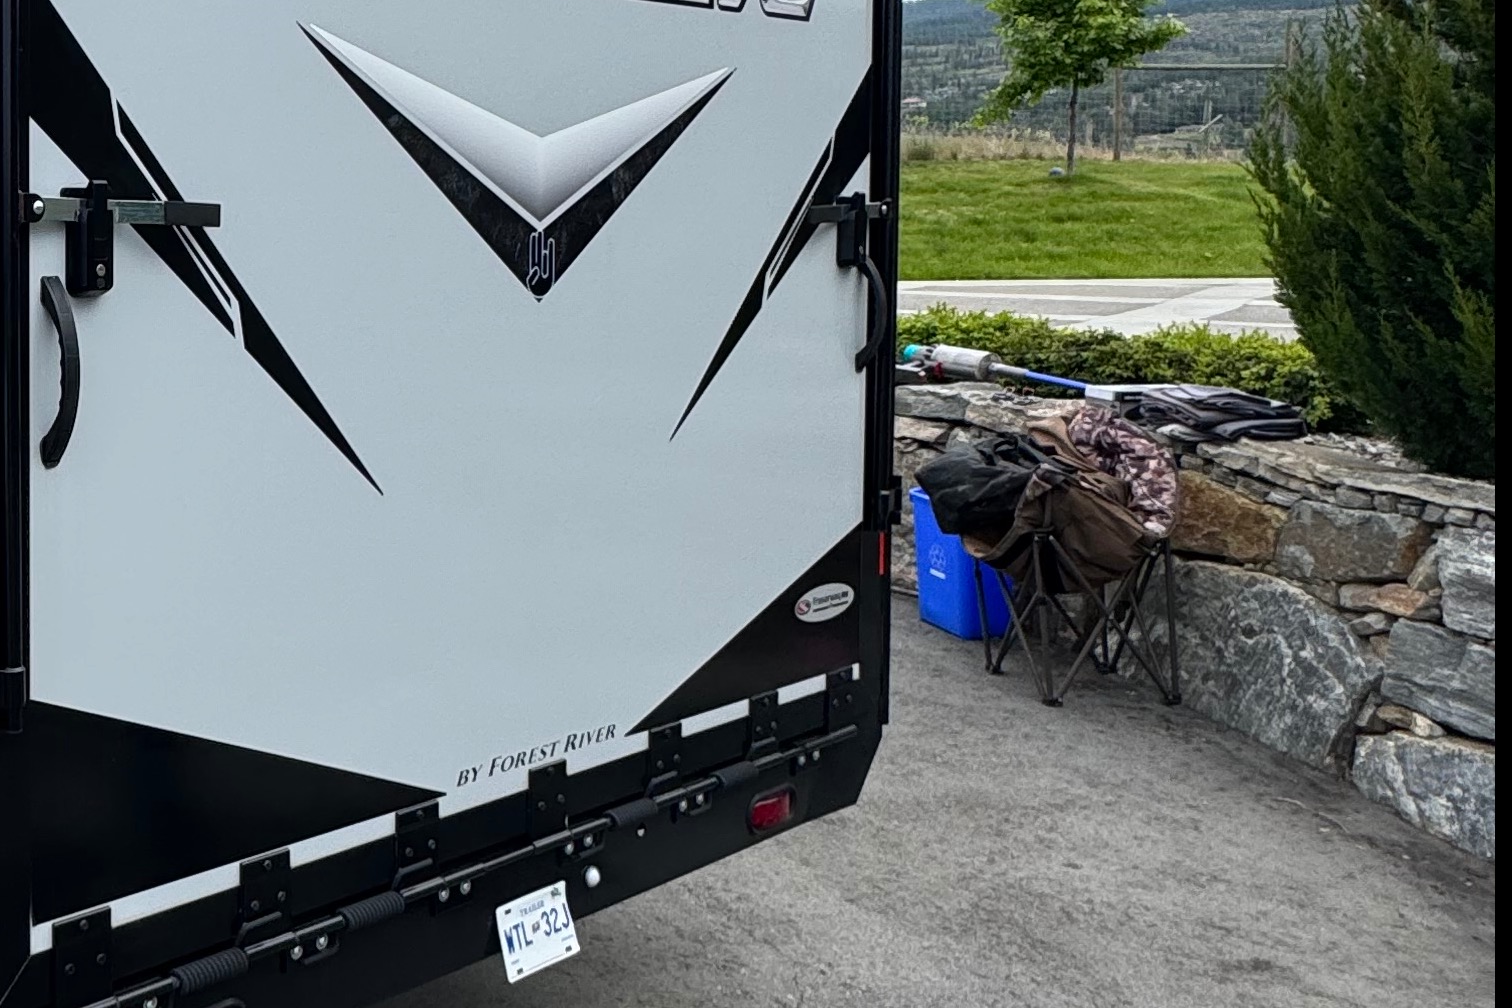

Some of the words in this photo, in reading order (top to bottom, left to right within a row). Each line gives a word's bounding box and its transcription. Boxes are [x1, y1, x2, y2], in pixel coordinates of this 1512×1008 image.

[456, 764, 483, 788] BY
[488, 739, 561, 778] FOREST
[563, 723, 617, 754] RIVER
[503, 920, 534, 955] WTL
[540, 902, 570, 937] 32J
